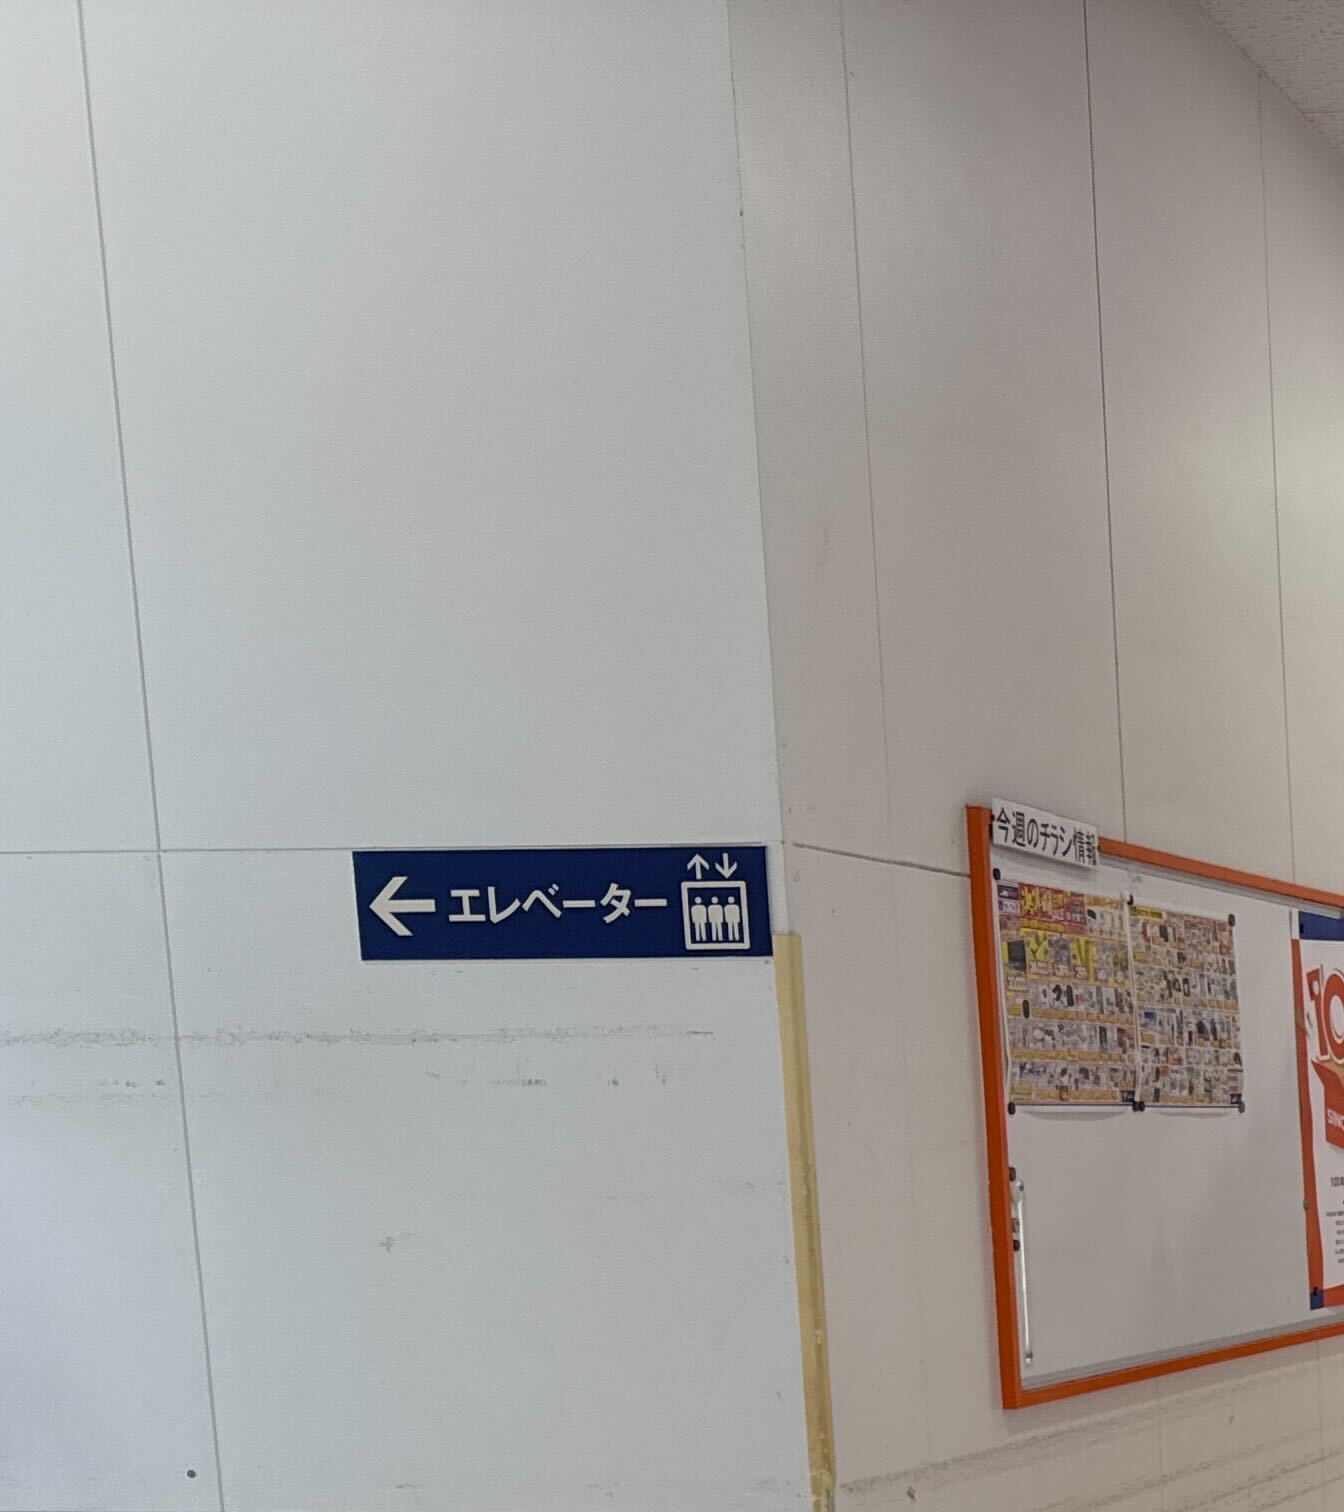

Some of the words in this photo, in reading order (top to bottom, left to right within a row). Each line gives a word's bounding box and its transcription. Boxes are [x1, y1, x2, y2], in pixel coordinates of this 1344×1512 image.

[996, 807, 1097, 866] 今週のチラシ情報
[448, 883, 668, 925] エレベーター
